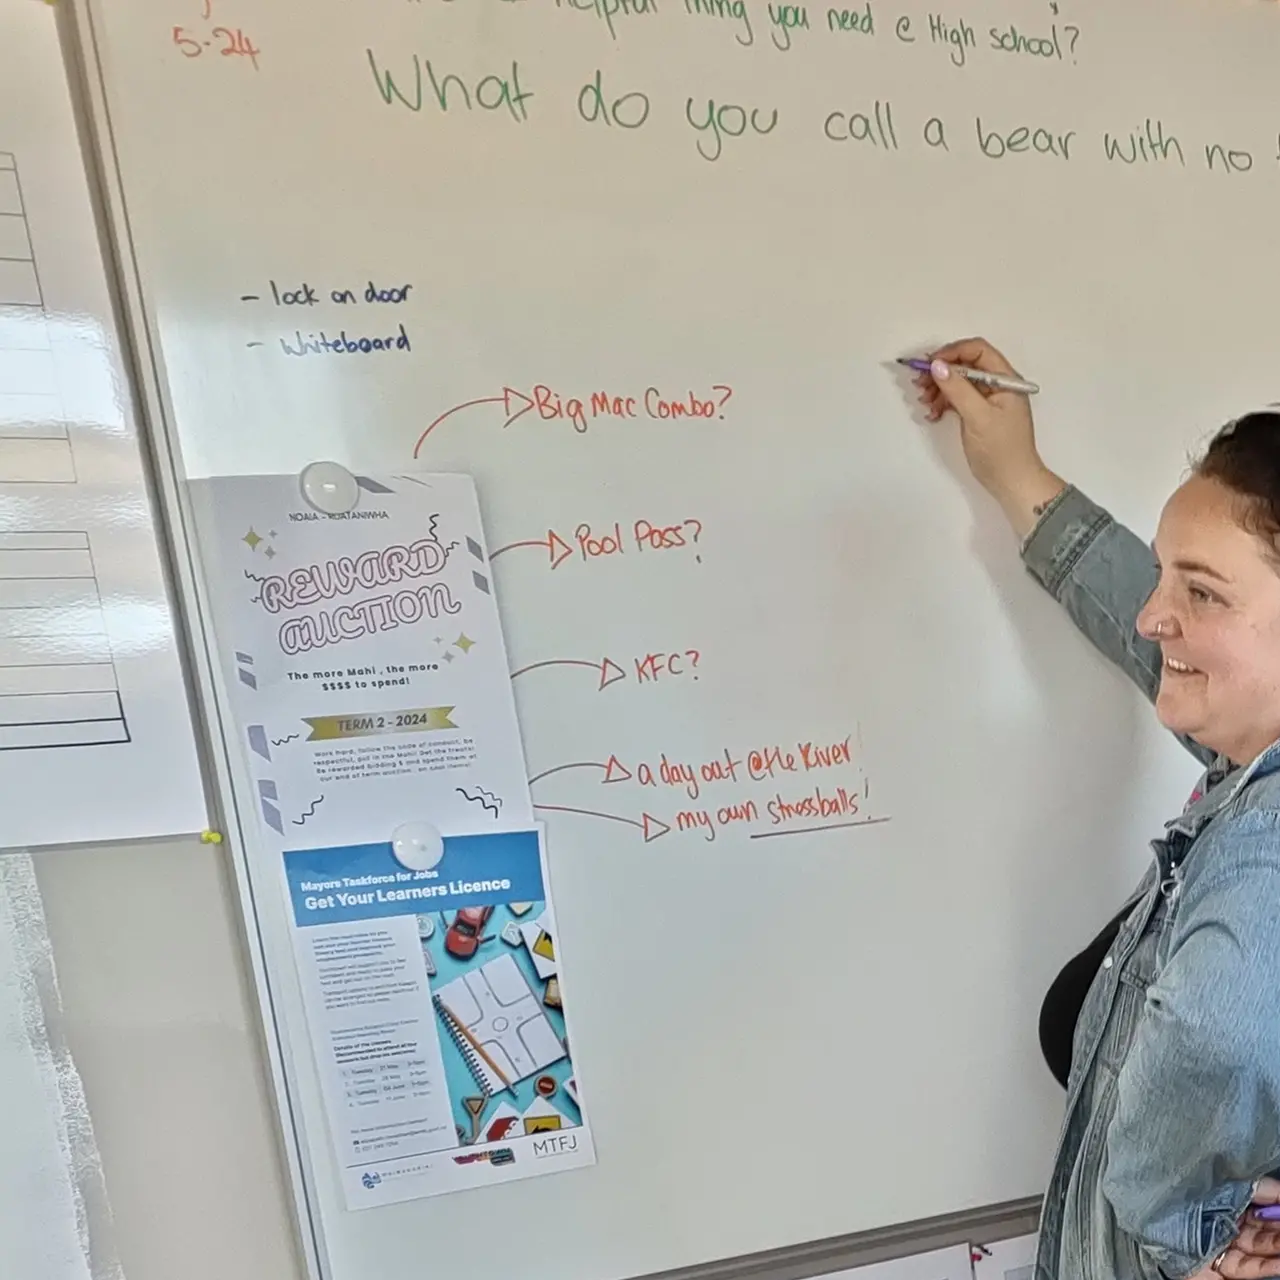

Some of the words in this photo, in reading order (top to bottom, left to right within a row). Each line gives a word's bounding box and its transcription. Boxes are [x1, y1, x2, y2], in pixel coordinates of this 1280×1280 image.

[556, 0, 658, 41] elpu
[768, 3, 809, 51] you
[827, 3, 874, 35] need
[928, 13, 976, 67] High
[366, 48, 534, 123] What
[578, 69, 650, 129] do
[686, 97, 778, 162] you
[824, 100, 898, 150] call
[923, 117, 950, 152] a
[976, 116, 1077, 160] bear
[1104, 117, 1185, 167] with
[1205, 143, 1253, 174] no
[269, 279, 320, 307] lock
[330, 288, 357, 304] on
[364, 280, 413, 304] door
[533, 384, 588, 434] Big
[590, 391, 637, 420] Mac
[644, 385, 732, 421] Combo?
[575, 523, 625, 562] Pool
[634, 519, 703, 564] Pass?
[259, 538, 448, 614] REWARD
[278, 582, 463, 656] AUCTION
[287, 671, 309, 681] The
[313, 670, 344, 679] more
[347, 666, 376, 677] Mahi
[386, 664, 405, 674] the
[408, 662, 439, 672] more
[322, 681, 351, 692] $$$$
[355, 680, 367, 690] to
[371, 677, 410, 691] spend!
[634, 650, 701, 685] KFC?
[337, 718, 375, 732] TERM
[377, 717, 385, 729] 2
[396, 713, 427, 728] 2024
[637, 763, 657, 787] a
[659, 753, 699, 800] day
[701, 748, 743, 783] out
[676, 809, 716, 842] my
[717, 800, 759, 826] own
[301, 879, 341, 893] Mayors
[342, 874, 395, 887] Taskforce
[396, 872, 412, 882] for
[413, 869, 439, 881] Jobs
[305, 894, 336, 910] Get
[336, 891, 376, 906] Your
[377, 884, 448, 903] Learners
[449, 876, 511, 896] Licence
[532, 1133, 578, 1157] MTFJ
